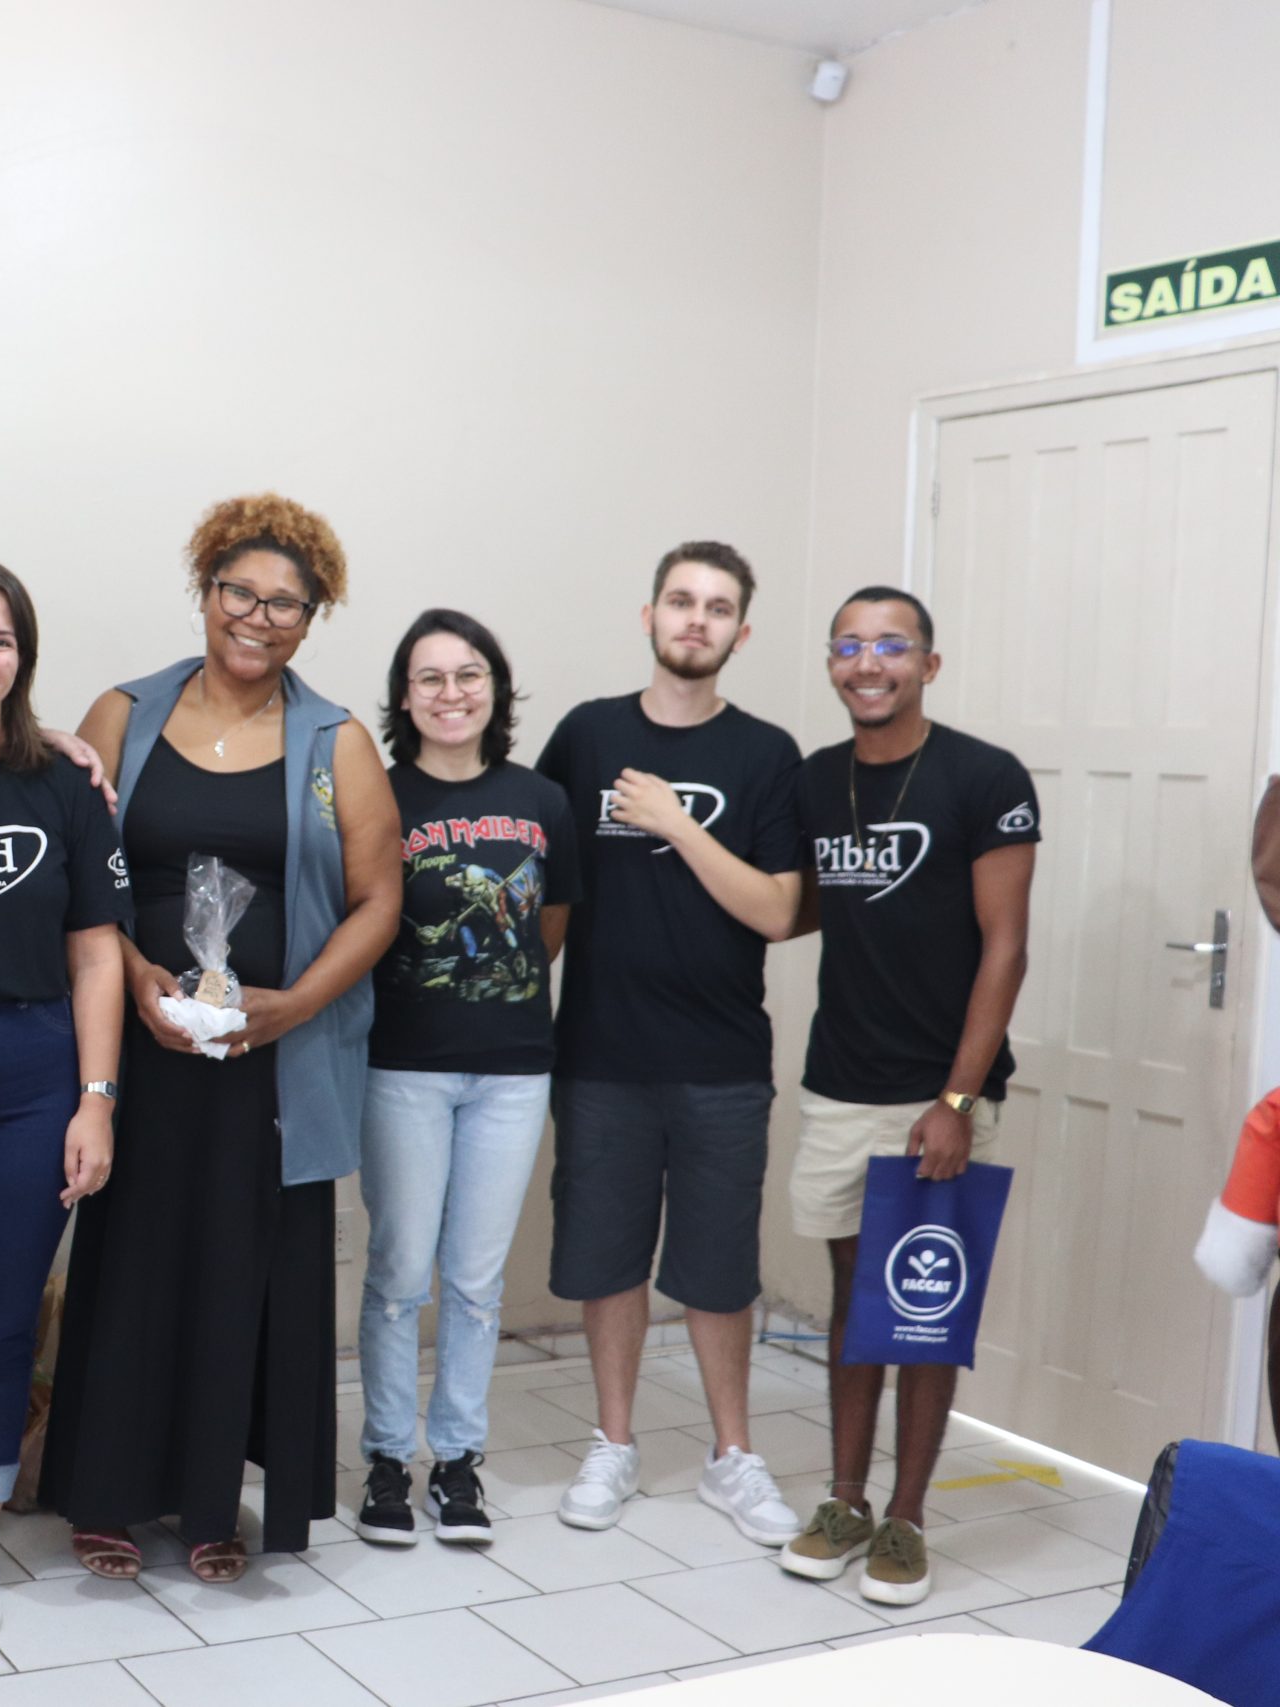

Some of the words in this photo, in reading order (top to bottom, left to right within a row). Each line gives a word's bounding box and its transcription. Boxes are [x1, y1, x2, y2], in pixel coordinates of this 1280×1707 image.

[1109, 258, 1277, 322] SAÍDA
[446, 815, 548, 857] MAIDEN
[815, 834, 902, 872] Pibid
[901, 1278, 952, 1293] FACCAT
